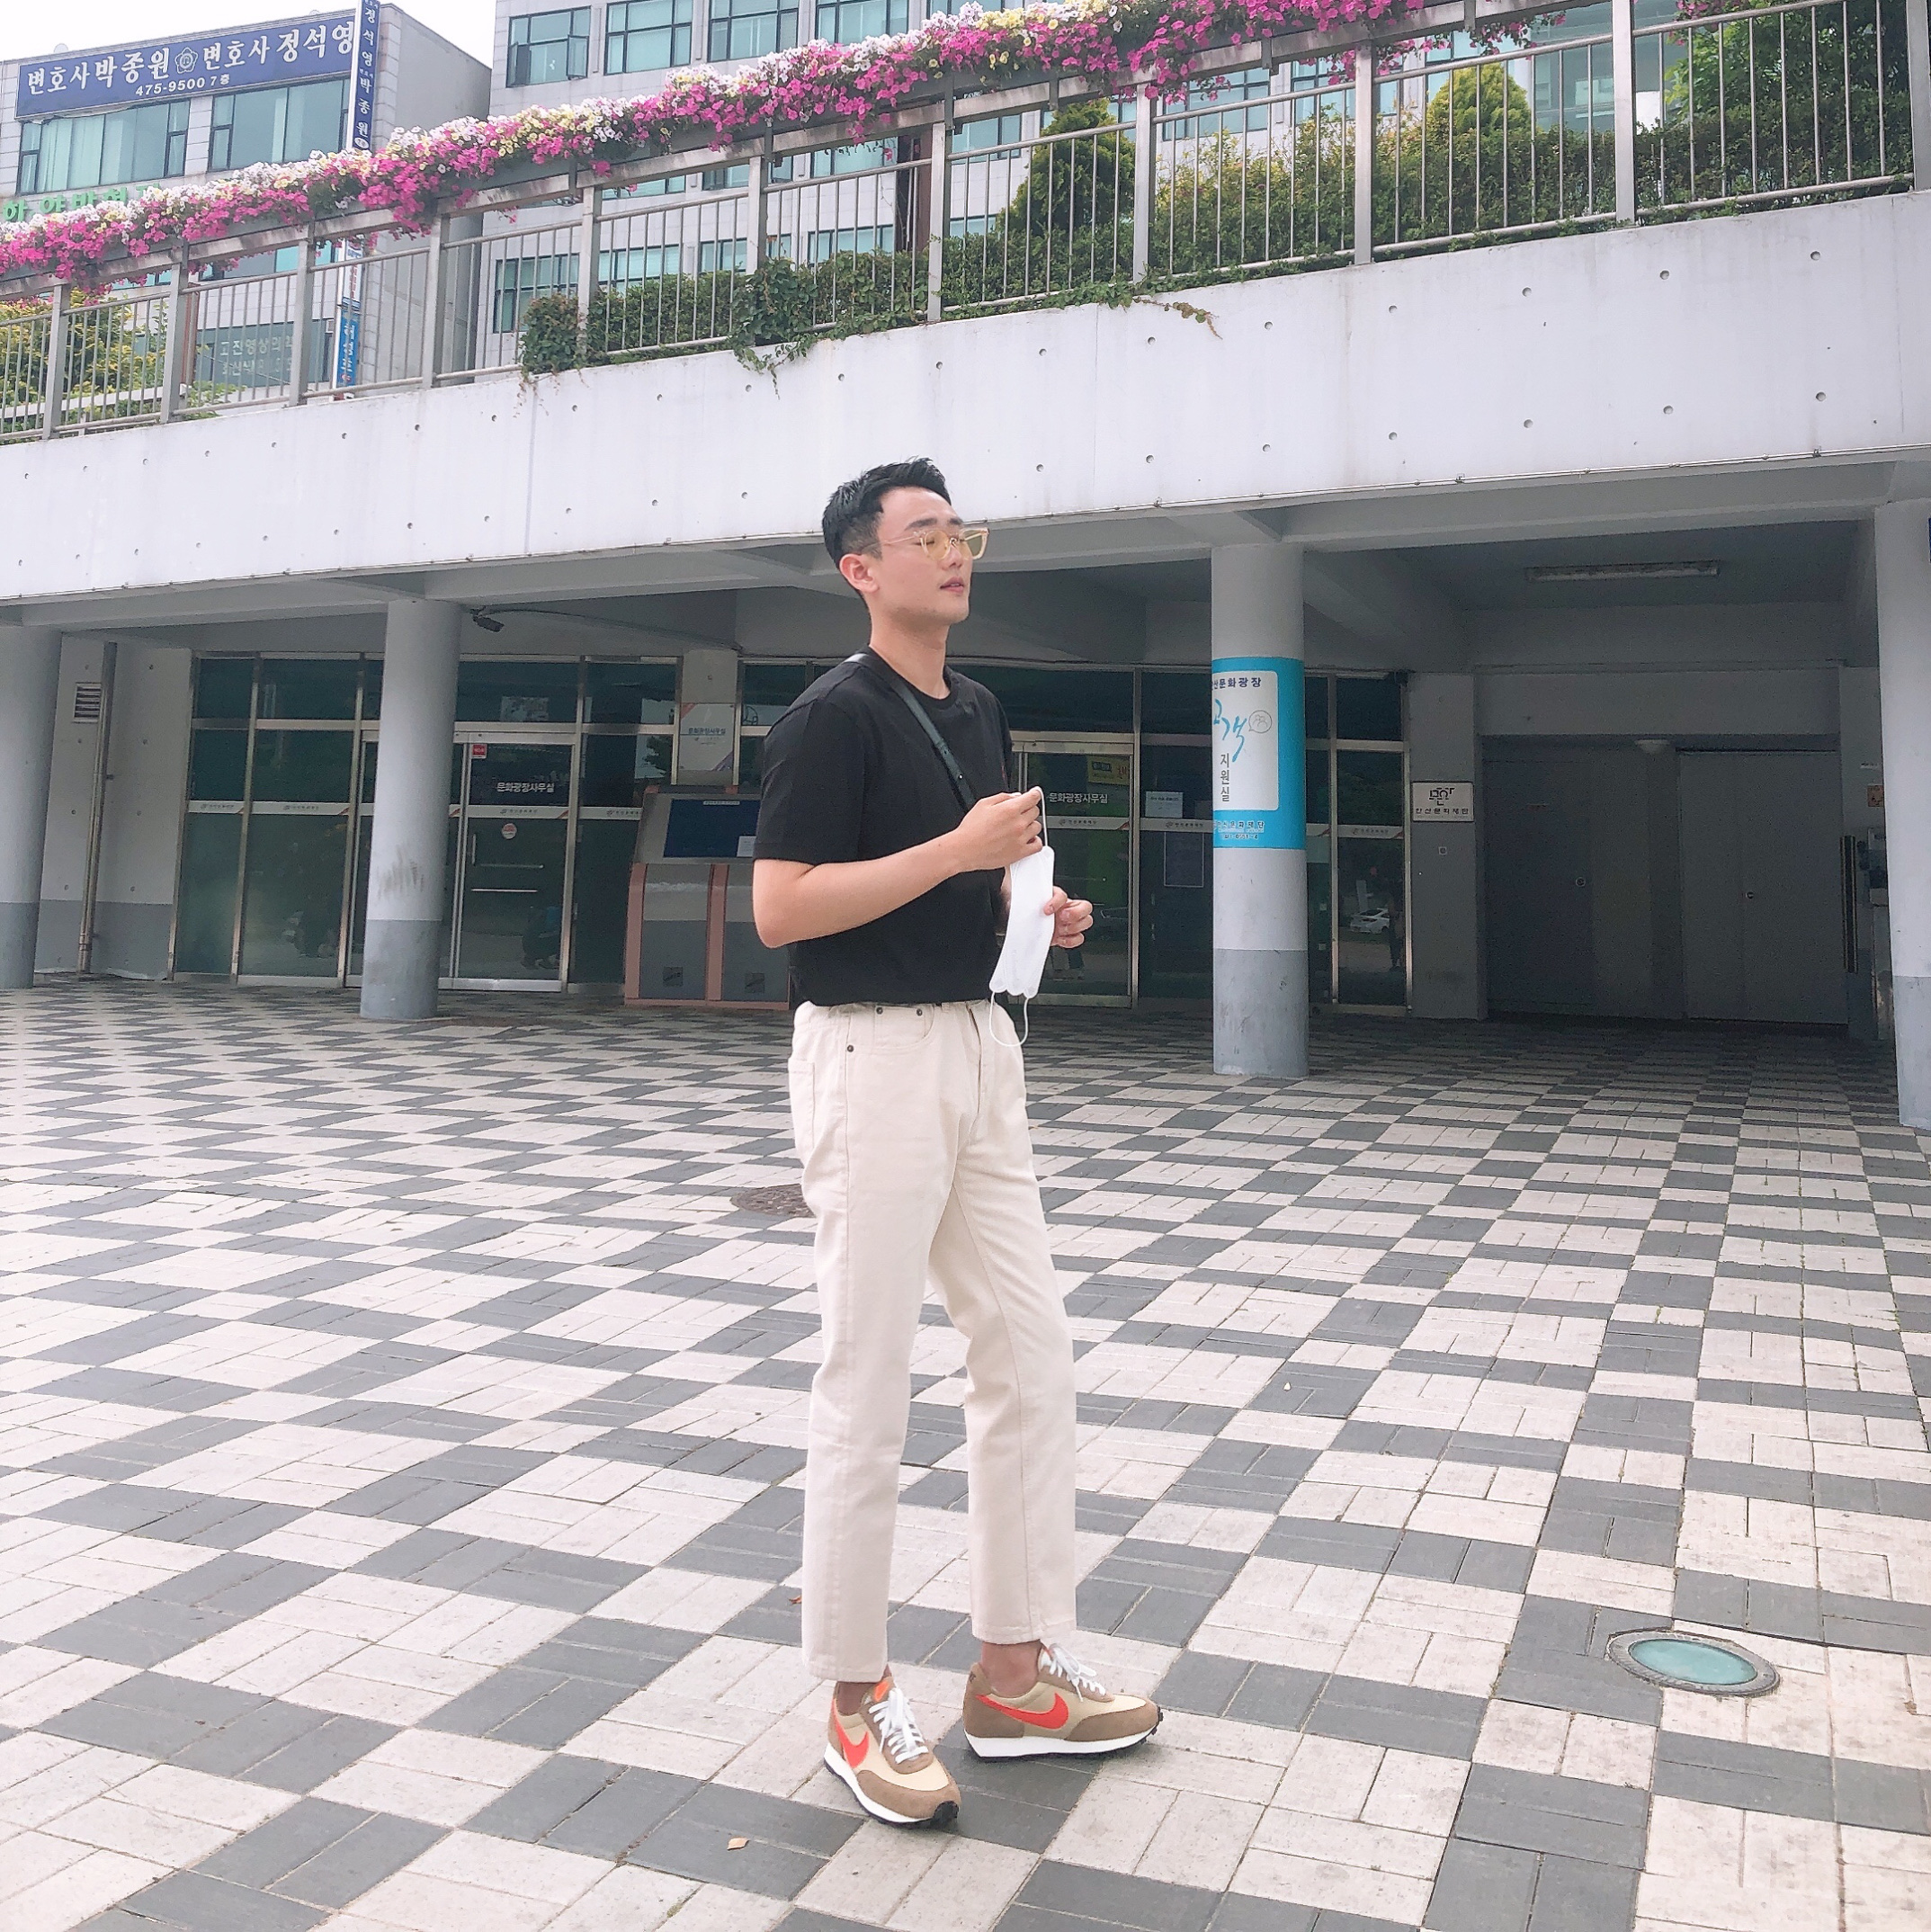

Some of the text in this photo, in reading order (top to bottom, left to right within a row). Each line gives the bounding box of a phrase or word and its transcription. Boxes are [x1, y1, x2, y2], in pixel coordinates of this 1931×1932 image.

[28, 21, 354, 95] 변호사 박종원 변호사 정석영
[135, 77, 205, 96] 475-9500
[1211, 677, 1261, 691] 산문화광장
[1220, 753, 1229, 802] 지원실
[496, 782, 555, 792] 문화광장사무실
[1049, 792, 1108, 804] 문화광장사무실
